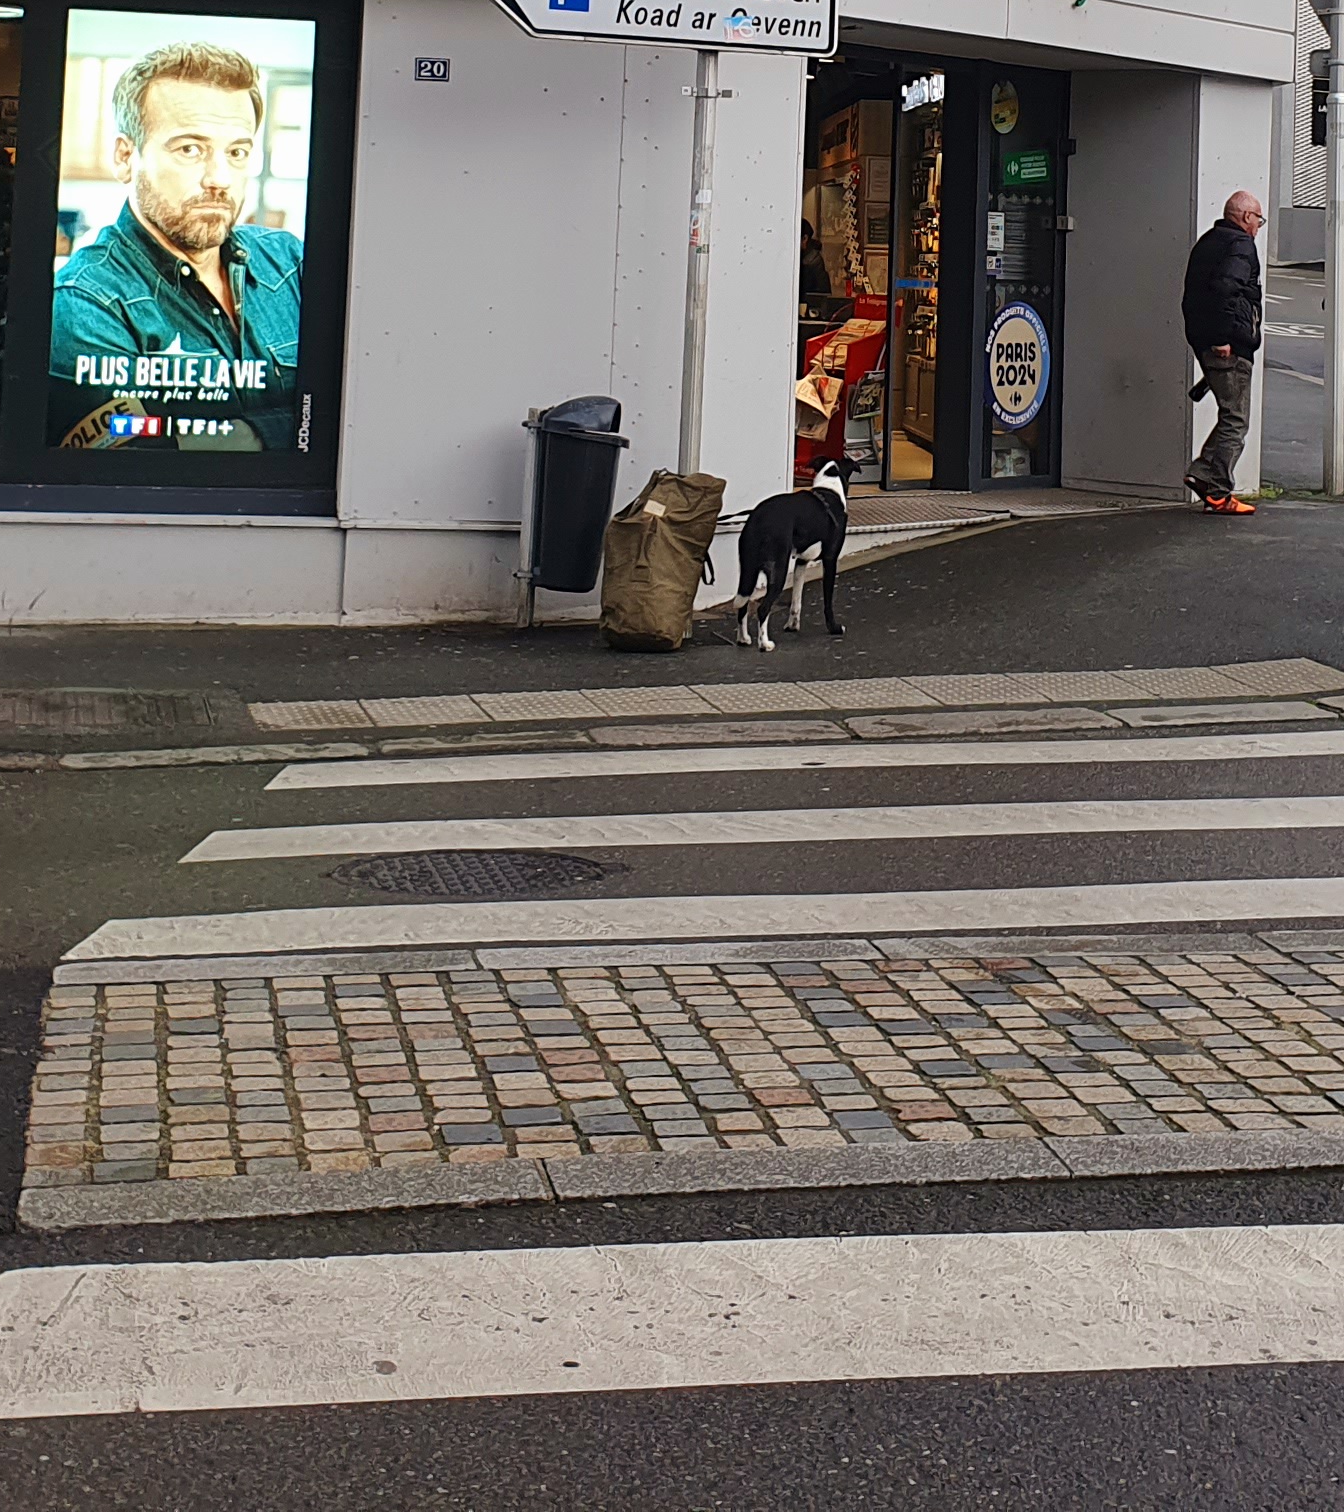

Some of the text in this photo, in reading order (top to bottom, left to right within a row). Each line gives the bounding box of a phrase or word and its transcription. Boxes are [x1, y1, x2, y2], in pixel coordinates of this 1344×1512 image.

[616, 0, 682, 28] Koad
[691, 10, 717, 30] ar
[420, 61, 444, 76] 20
[985, 306, 1047, 353] NOS PRODUITS OFFICIELS
[996, 342, 1036, 363] PARIS
[75, 355, 267, 389] PLUS BELLE LA VIE
[996, 364, 1036, 386] 2024
[112, 388, 230, 404] encore plus belle
[112, 417, 234, 436] TF1 TF1+
[298, 393, 312, 452] JCDecaux
